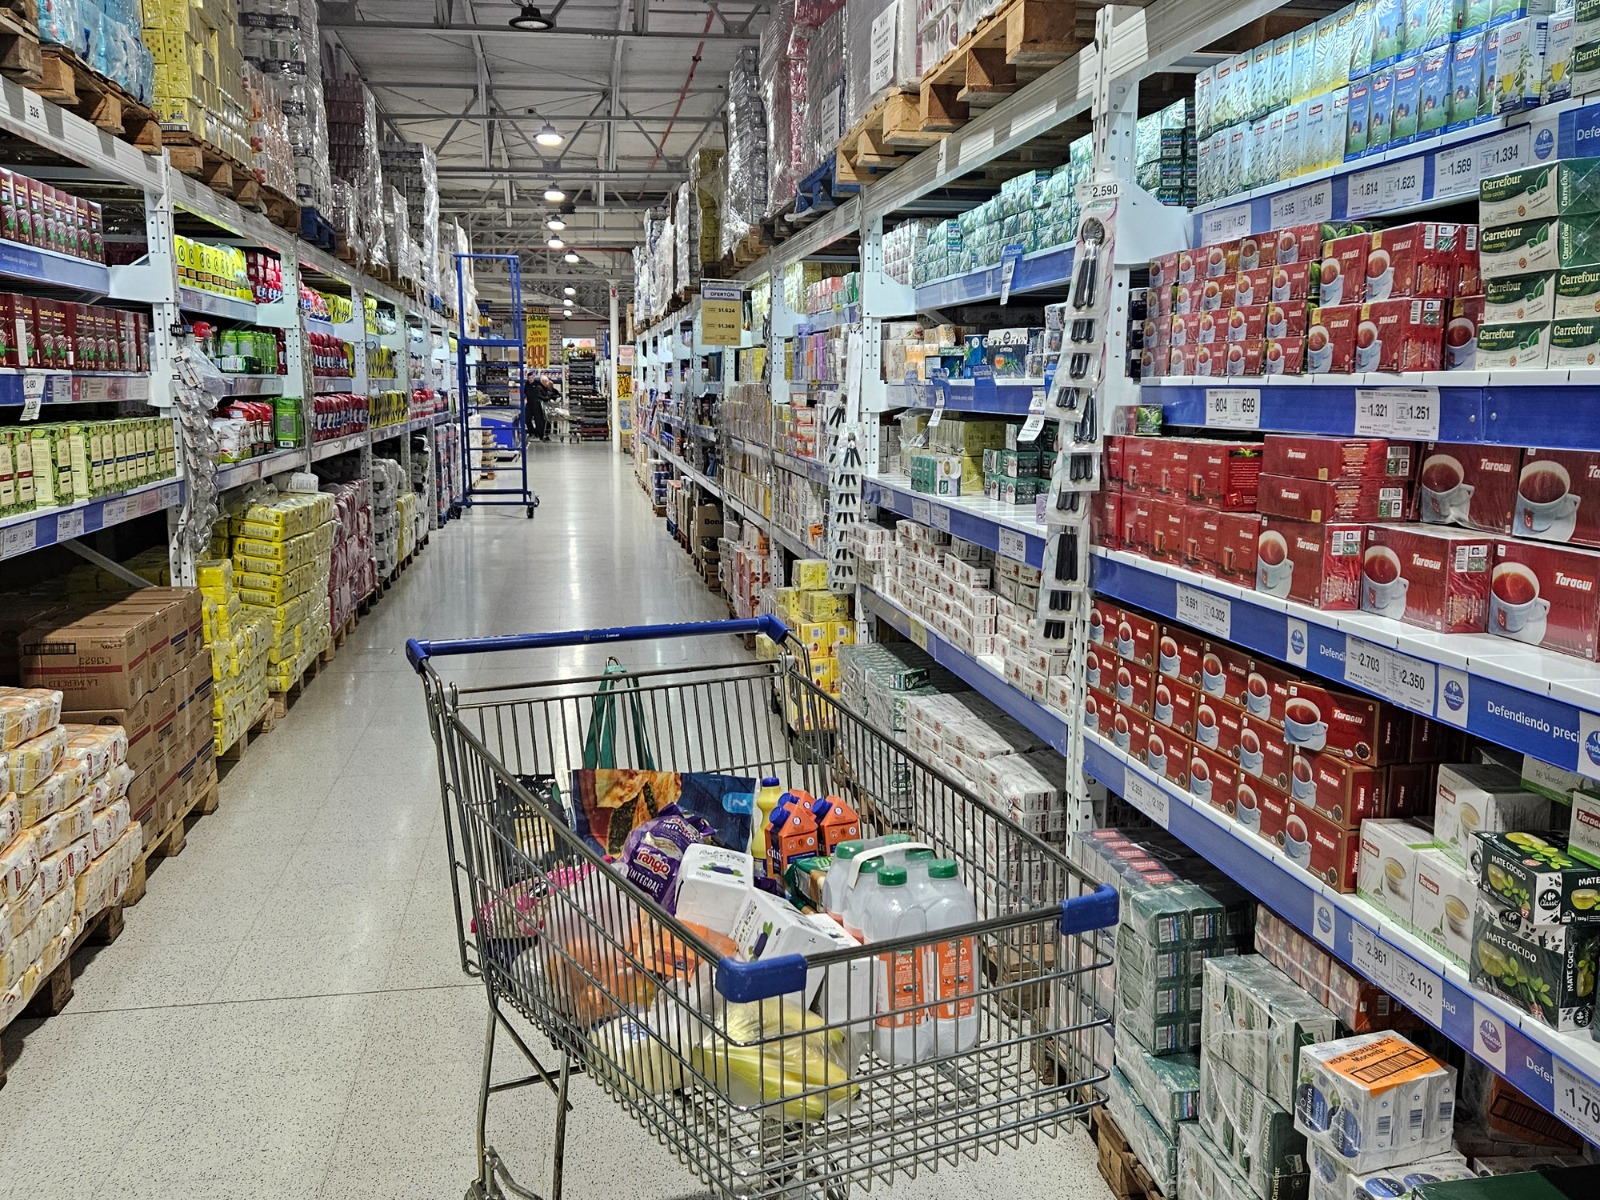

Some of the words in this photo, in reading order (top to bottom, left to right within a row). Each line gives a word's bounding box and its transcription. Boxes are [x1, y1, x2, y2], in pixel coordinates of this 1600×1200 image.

[1482, 174, 1522, 191] Carrefour
[1482, 226, 1522, 242] Carrefour
[1560, 271, 1600, 286] Carrefour
[1488, 281, 1522, 293] Carrefour
[1480, 329, 1515, 340] Carrefour
[1554, 324, 1594, 336] Carrefour
[1487, 700, 1551, 733] Defendiendo
[1491, 855, 1506, 868] MATE
[1506, 862, 1526, 881] COCIDO
[628, 869, 660, 893] INTEGRAL
[1578, 877, 1600, 886] MATE
[1486, 931, 1506, 947] MATE
[1507, 940, 1537, 963] COCIDO
